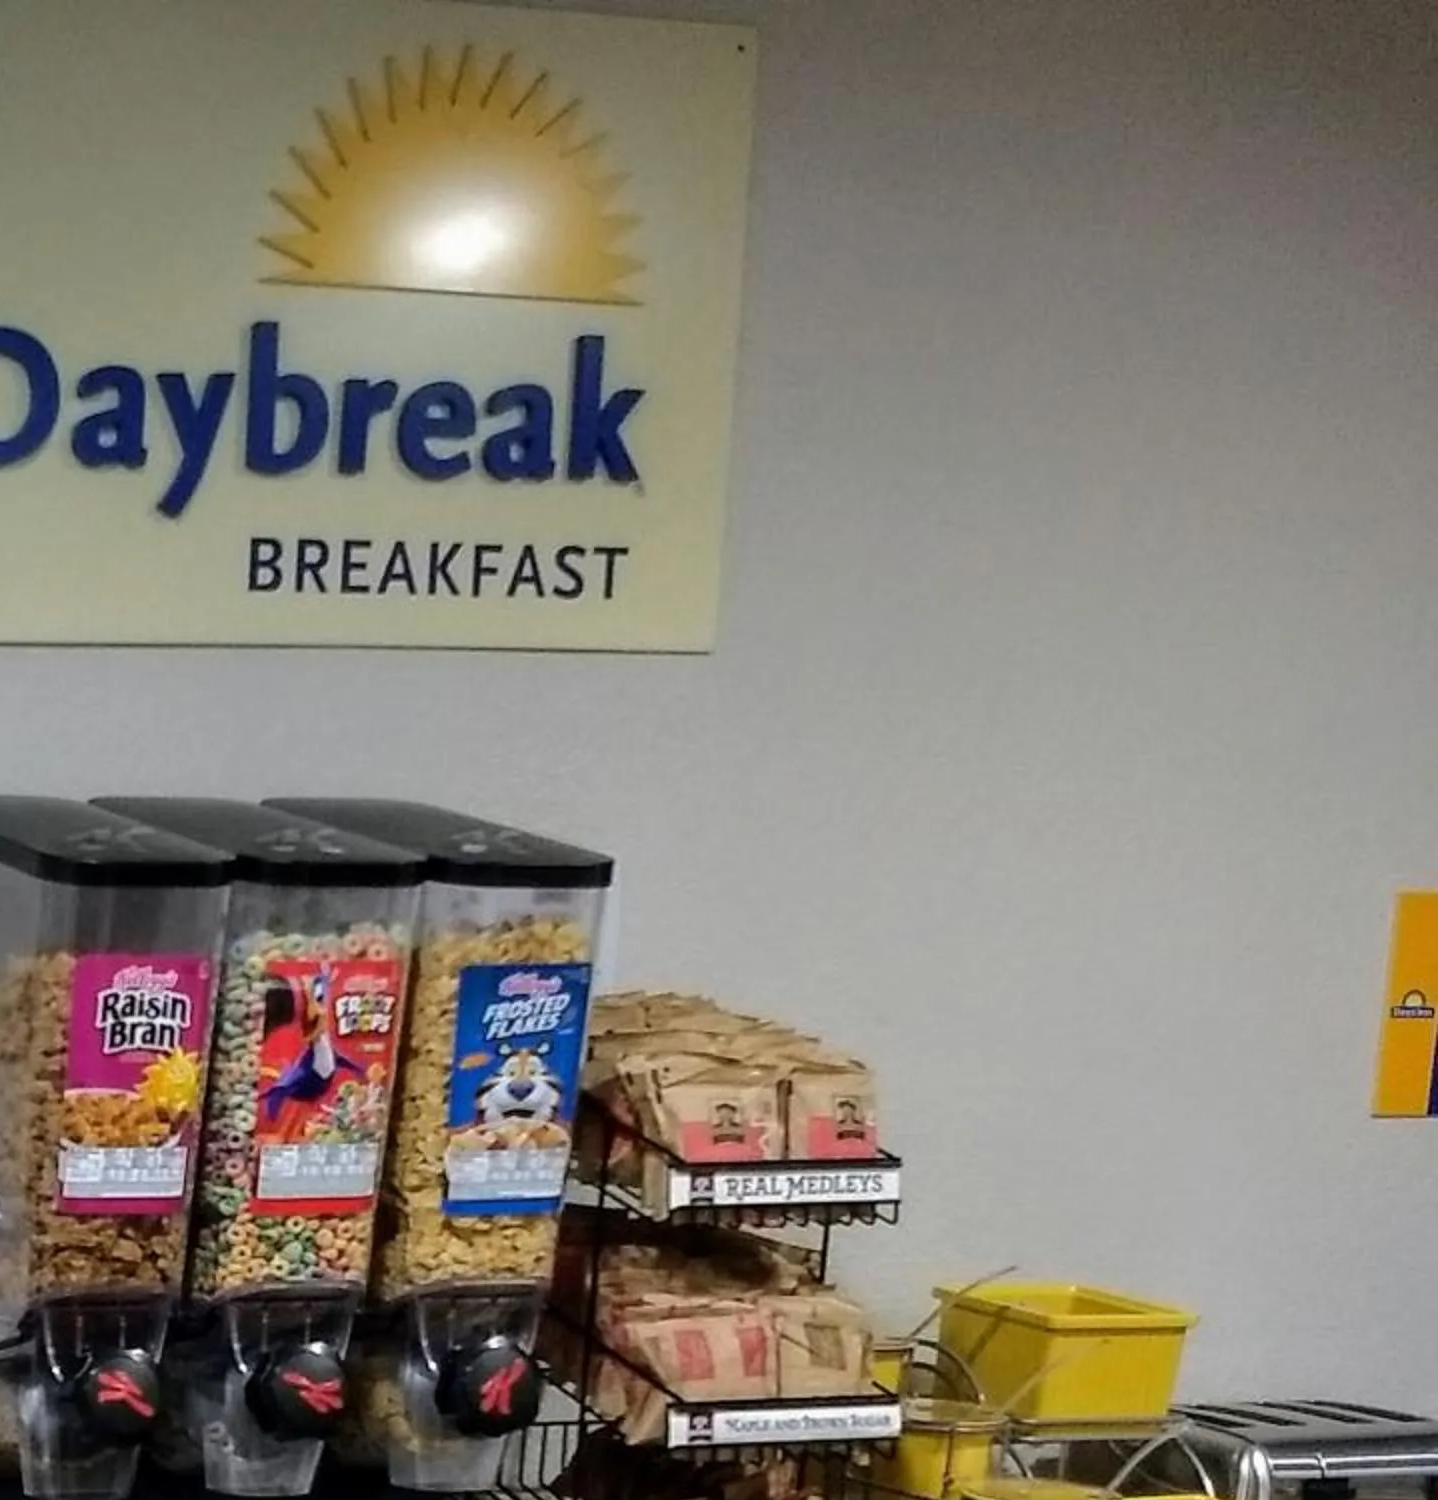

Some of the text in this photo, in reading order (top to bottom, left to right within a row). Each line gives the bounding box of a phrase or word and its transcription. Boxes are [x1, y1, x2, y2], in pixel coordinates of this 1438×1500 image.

[247, 536, 630, 601] BREAKFAST
[100, 991, 188, 1026] Raisin
[481, 992, 571, 1024] FROSTED
[107, 1020, 176, 1050] Bran
[485, 1014, 561, 1041] FLAKES
[724, 1174, 884, 1200] REAL MEDLEYS
